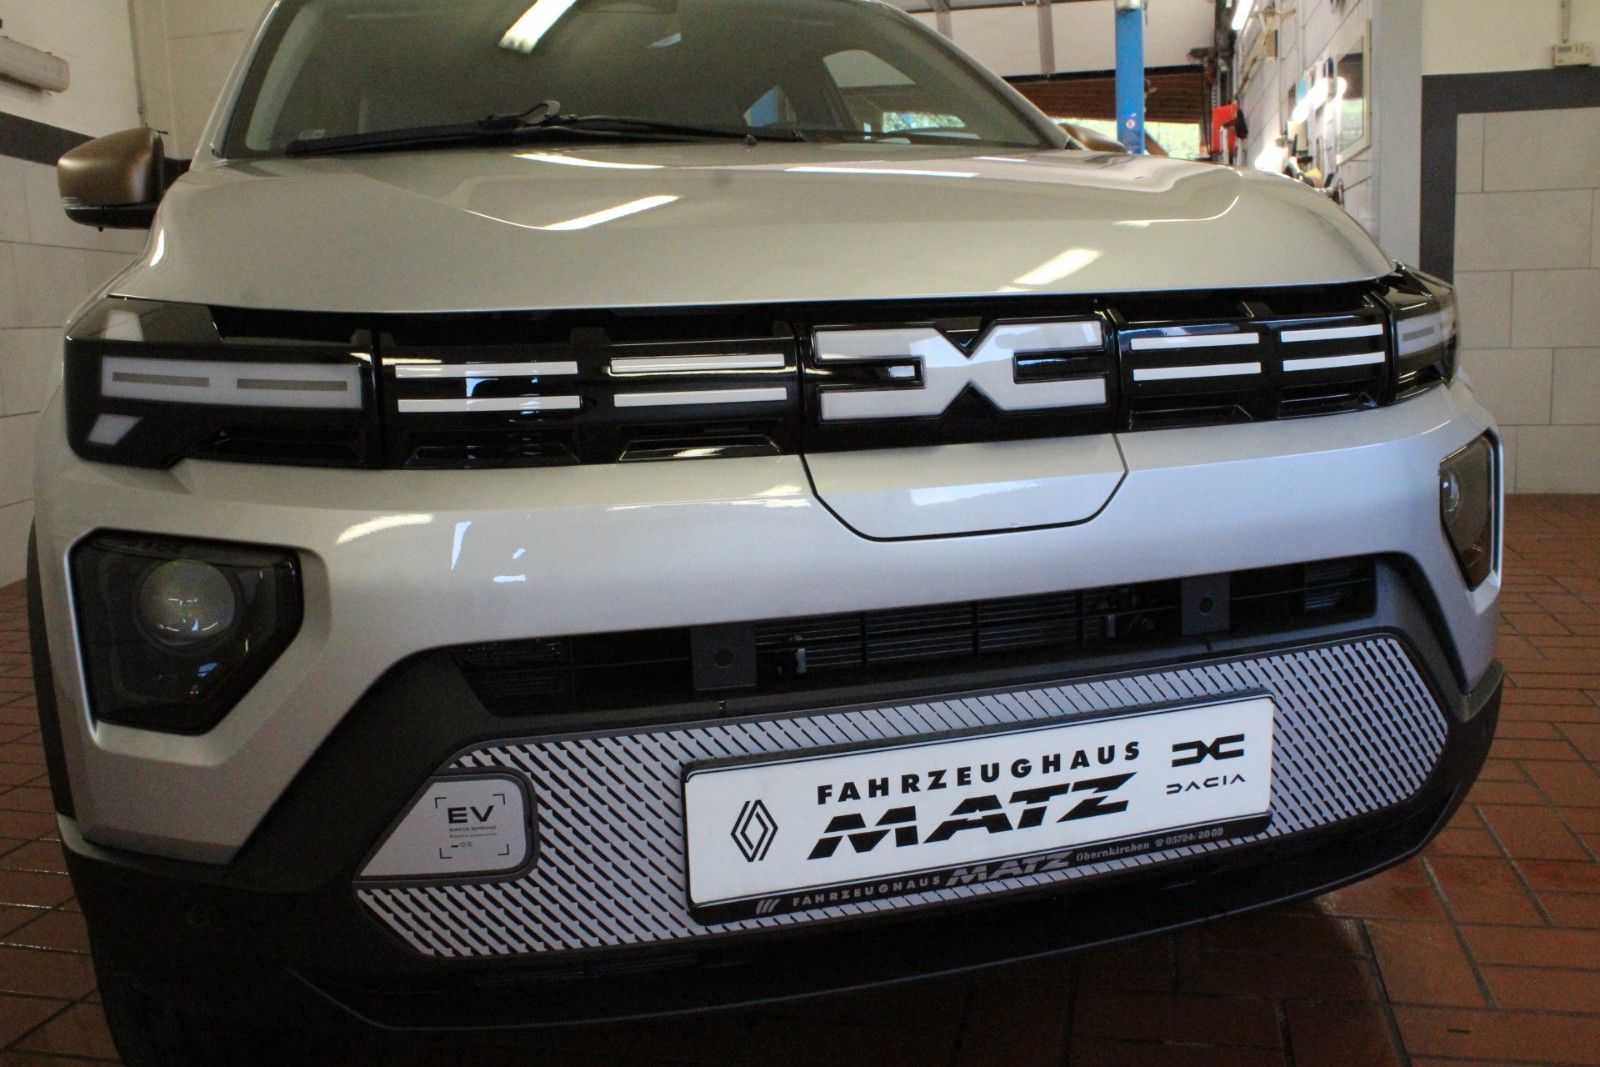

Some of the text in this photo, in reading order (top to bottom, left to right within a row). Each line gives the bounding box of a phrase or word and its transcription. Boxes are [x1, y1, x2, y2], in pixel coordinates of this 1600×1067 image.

[817, 741, 1140, 805] FAHRZEUGHAUS
[1166, 773, 1246, 795] DACIA
[447, 805, 494, 824] EV
[807, 772, 1137, 860] MATZ
[792, 876, 941, 907] FAHRZEUGHAUS
[945, 851, 1073, 887] MATZ
